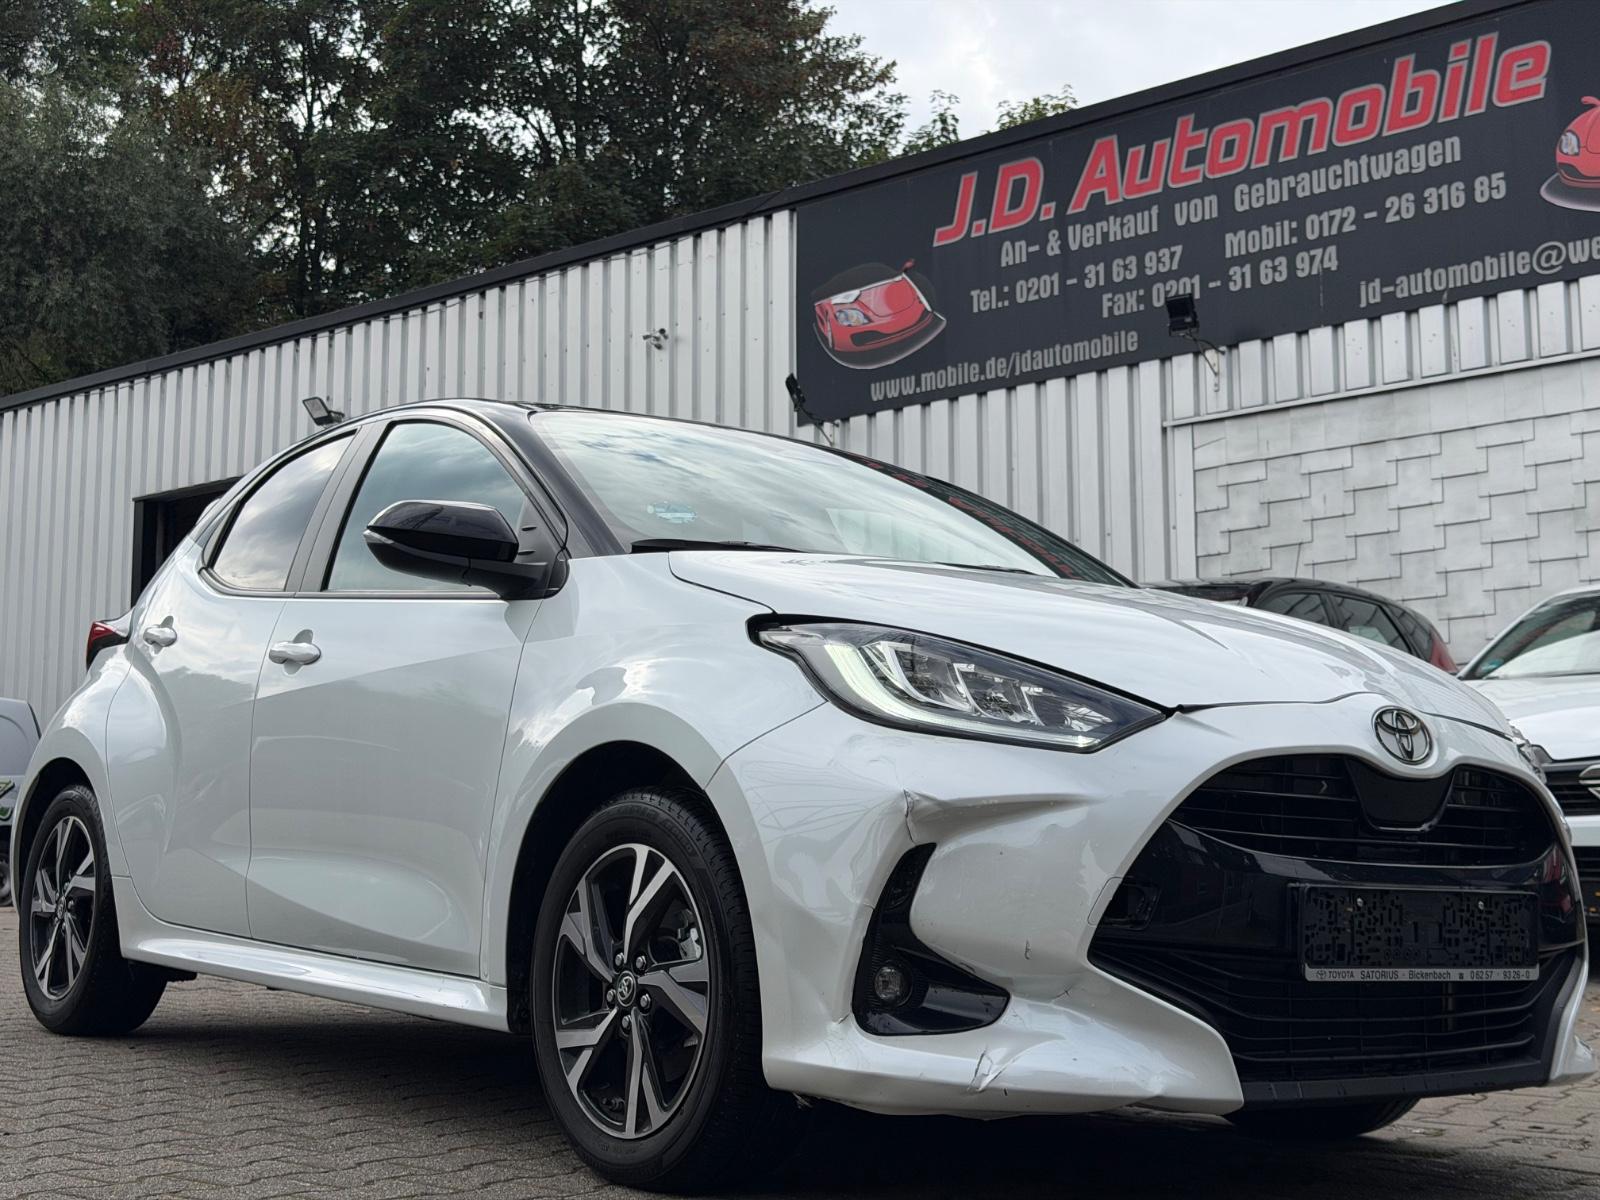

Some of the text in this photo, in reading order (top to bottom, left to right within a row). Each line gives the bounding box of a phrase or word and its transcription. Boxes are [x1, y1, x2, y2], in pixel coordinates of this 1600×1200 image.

[932, 31, 1551, 247] J.D. Automobile
[1000, 135, 1462, 267] An- & Verkauf von Gebrauchtwagen
[1225, 220, 1298, 258] Mobil:
[1305, 206, 1357, 241] 0172
[1385, 192, 1415, 224] 26
[1423, 181, 1466, 214] 316
[1474, 172, 1507, 203] 85
[970, 284, 1009, 313] Tel.:
[1015, 273, 1060, 304] 0201
[1084, 262, 1105, 289] 31
[1112, 255, 1138, 284] 63
[1144, 245, 1184, 275] 937
[1102, 289, 1145, 319] Fax:
[1228, 264, 1251, 292] 31
[1260, 256, 1288, 286] 63
[1296, 245, 1339, 277] 974
[870, 330, 1139, 402] www.mobile.de/jdautomobile
[1328, 970, 1355, 979] TOYOTA
[1360, 970, 1399, 980] SATORIUS
[1408, 970, 1451, 980] Bickenbach
